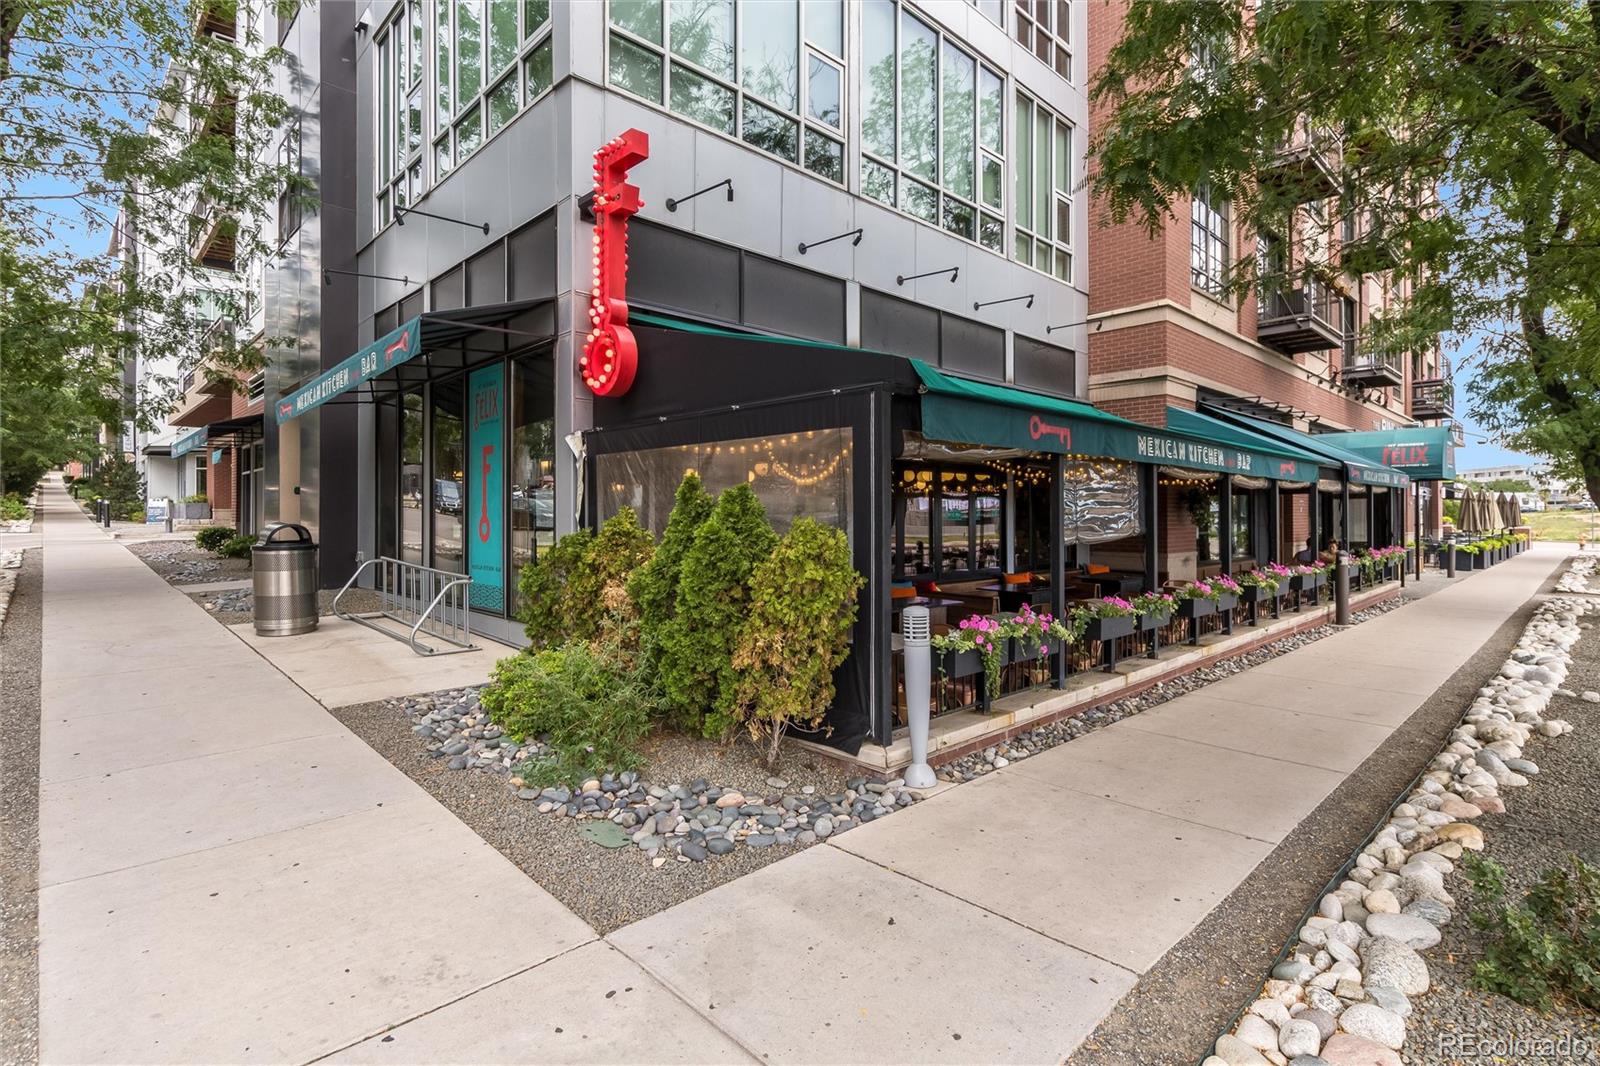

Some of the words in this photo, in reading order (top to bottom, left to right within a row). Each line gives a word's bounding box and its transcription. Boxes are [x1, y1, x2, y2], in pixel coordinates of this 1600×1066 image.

[296, 385, 322, 410] MEXICAN
[322, 368, 349, 398] KITCHEN
[361, 351, 378, 376] BAR
[473, 384, 499, 432] FELIX
[1137, 435, 1186, 460] MEXICAN
[1188, 443, 1225, 467] KITCHEN
[1236, 452, 1251, 470] BAR
[1382, 445, 1429, 465] FELIX
